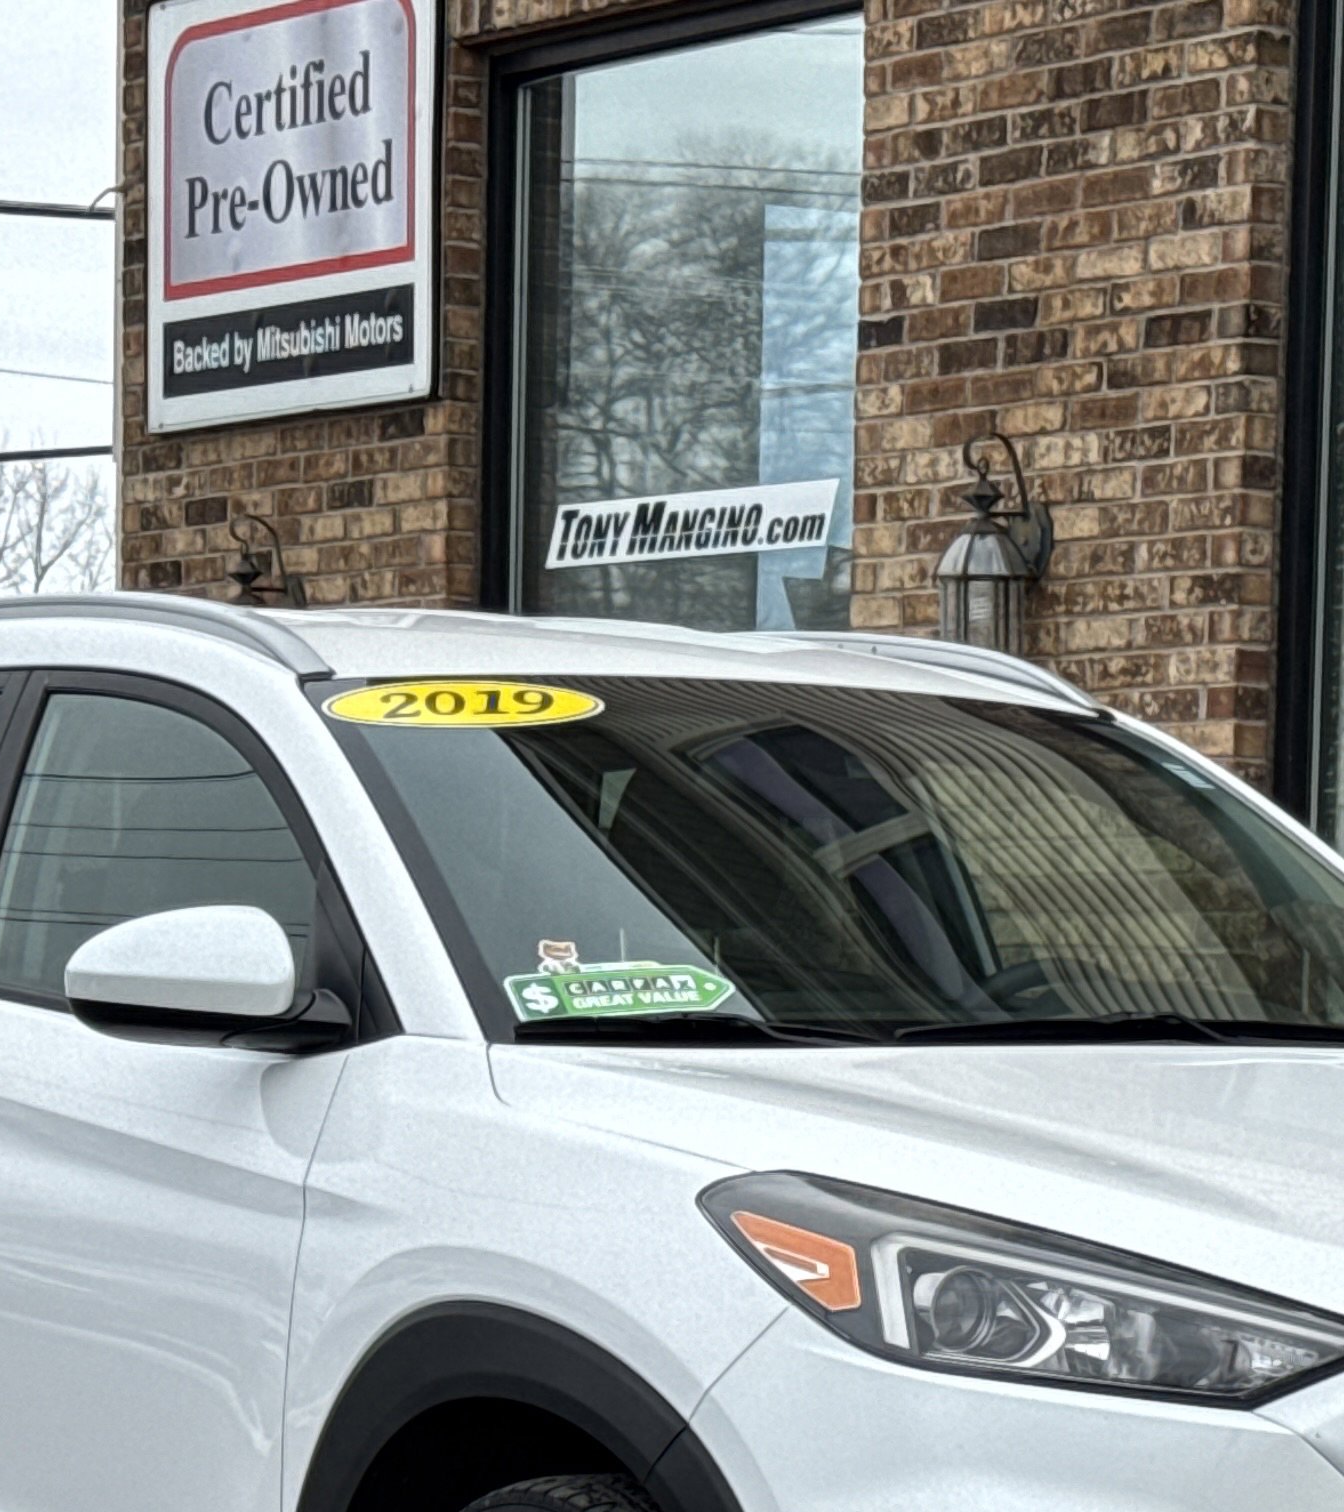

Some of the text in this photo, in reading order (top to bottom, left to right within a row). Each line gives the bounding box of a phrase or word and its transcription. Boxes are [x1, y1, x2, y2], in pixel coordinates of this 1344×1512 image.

[203, 50, 371, 145] Certified
[184, 139, 394, 239] Pre-Owned
[173, 312, 404, 374] Backed by Mitsubishi Motors
[380, 689, 554, 719] 2019
[566, 975, 695, 996] CARFAX
[572, 990, 701, 1009] GREAT VALUE
